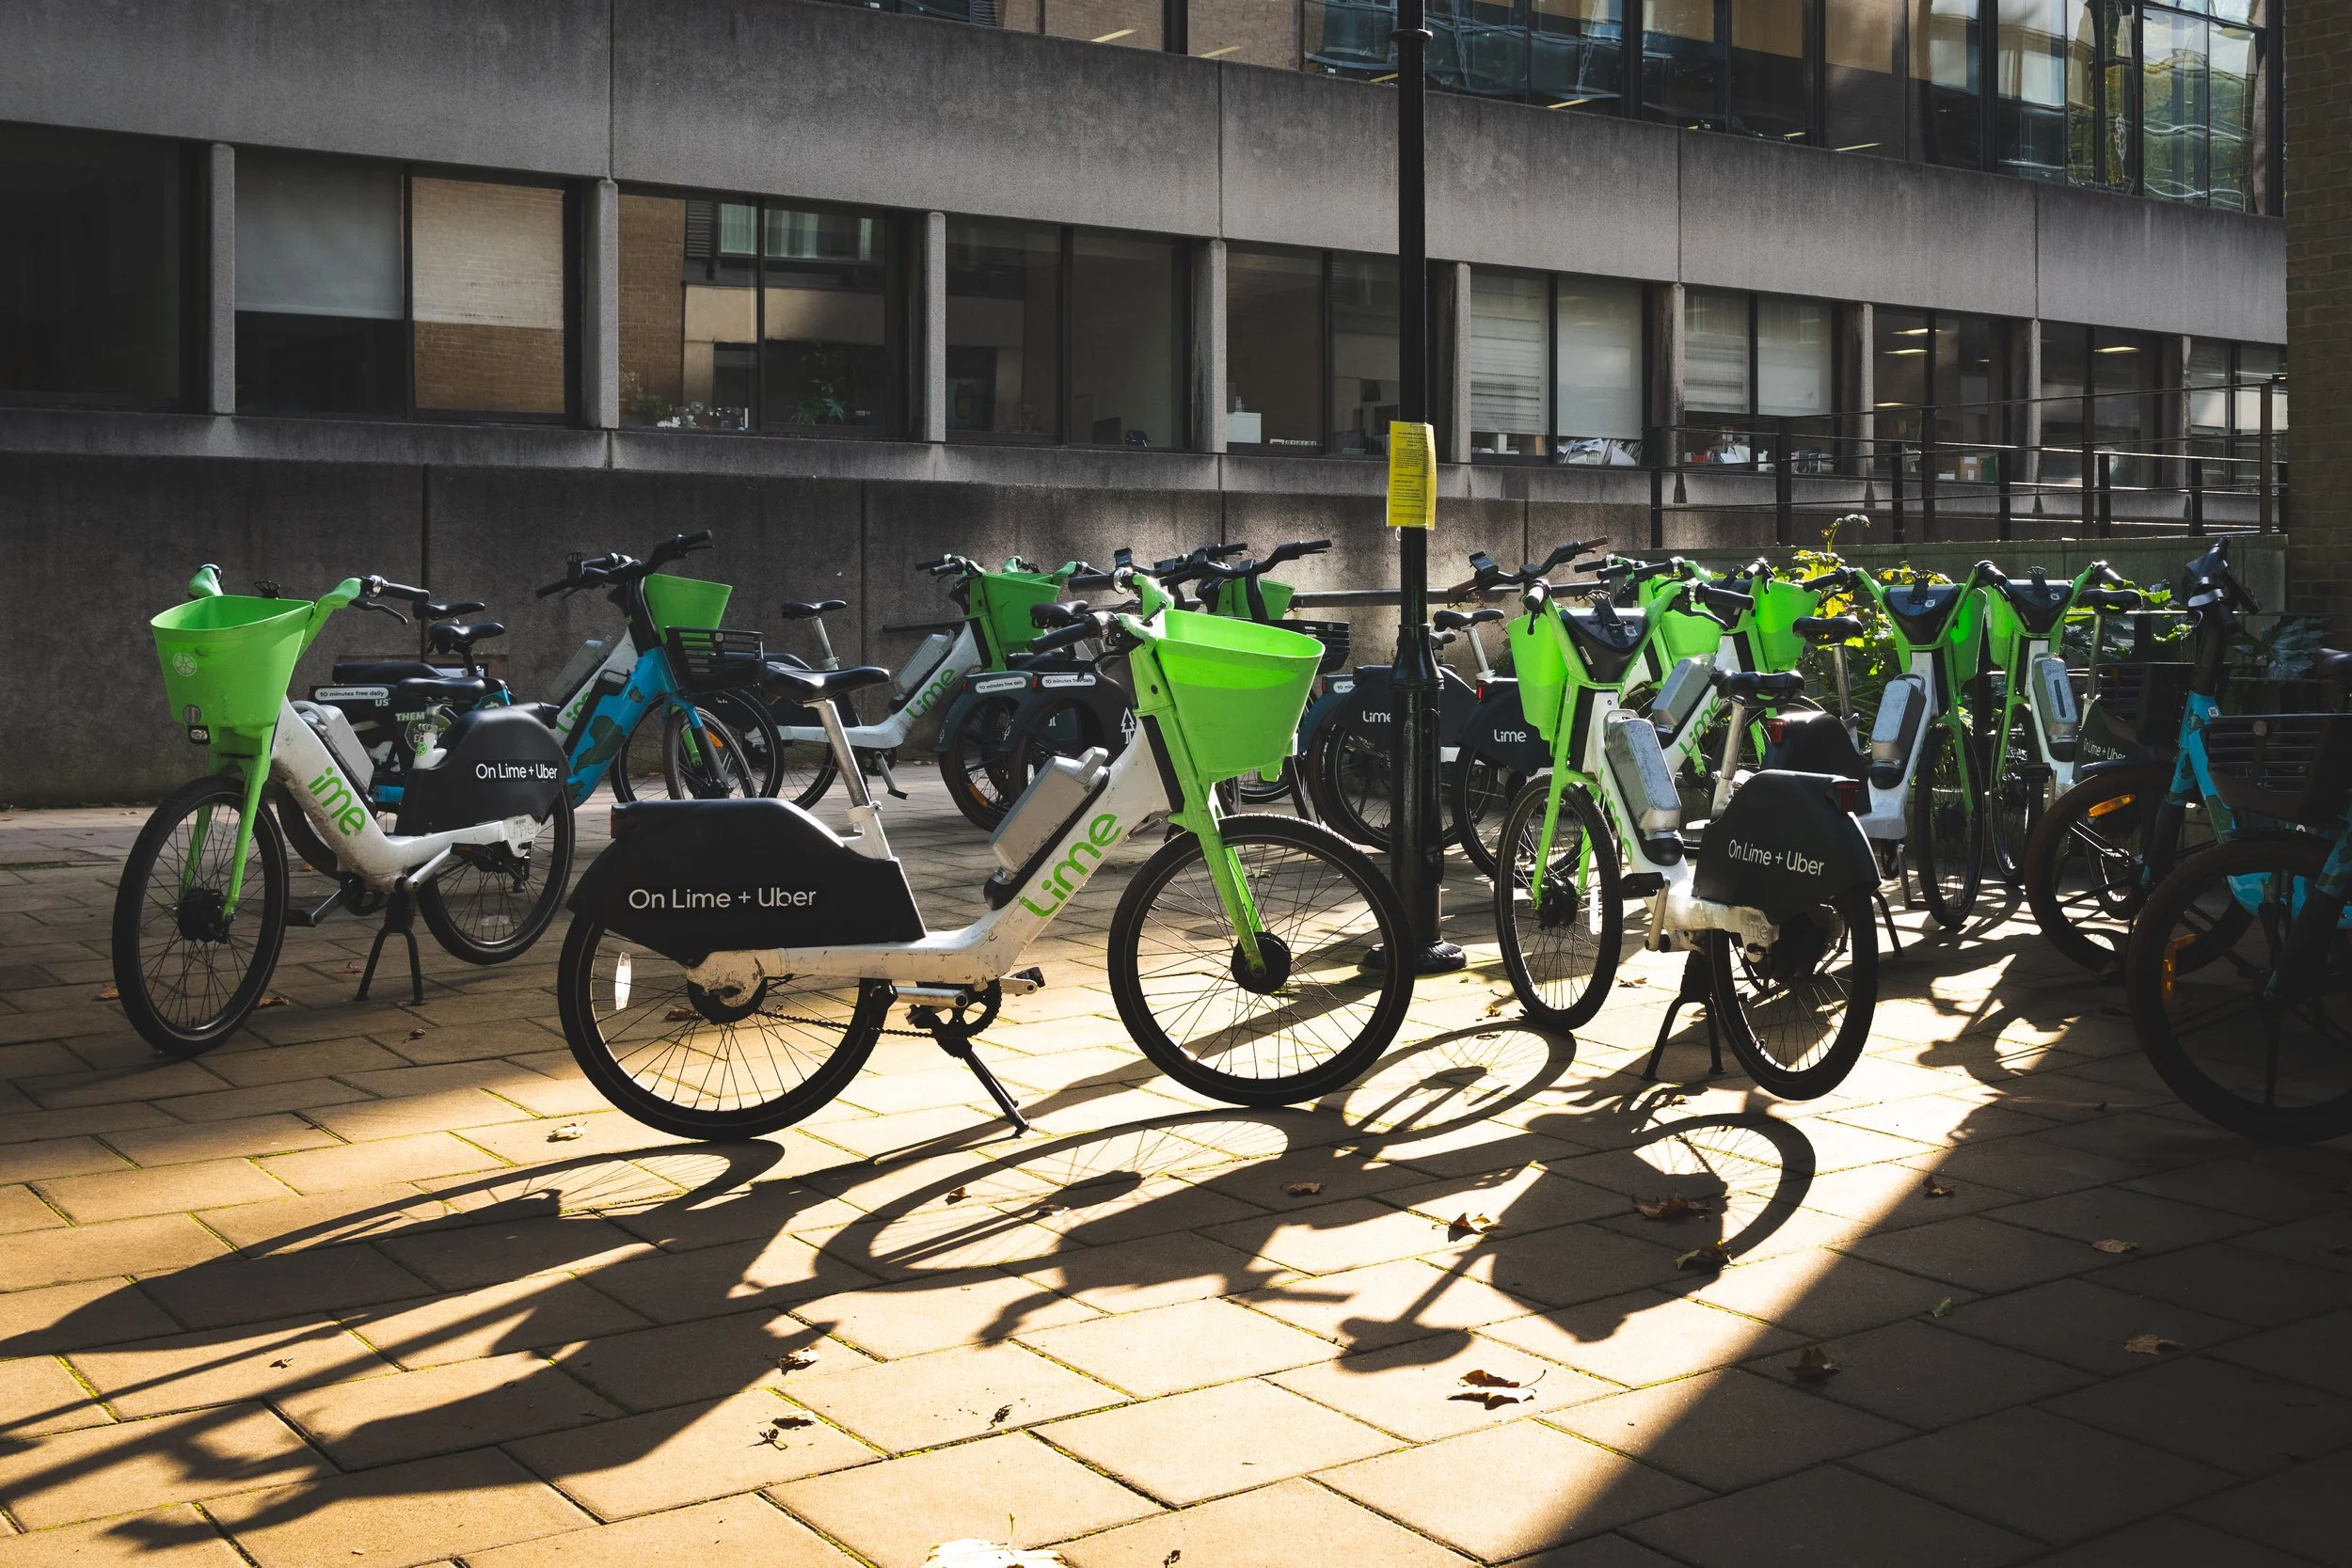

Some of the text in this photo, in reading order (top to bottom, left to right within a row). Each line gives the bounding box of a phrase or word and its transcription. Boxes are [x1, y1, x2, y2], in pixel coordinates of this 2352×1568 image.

[905, 669, 956, 719] Lime
[395, 711, 424, 721] THEM
[1493, 729, 1527, 742] Lime
[476, 763, 558, 779] On Lime + Uber
[1020, 814, 1121, 917] Lime
[1728, 839, 1825, 877] On Lime + Uber
[628, 887, 817, 910] On Lime + Uber
